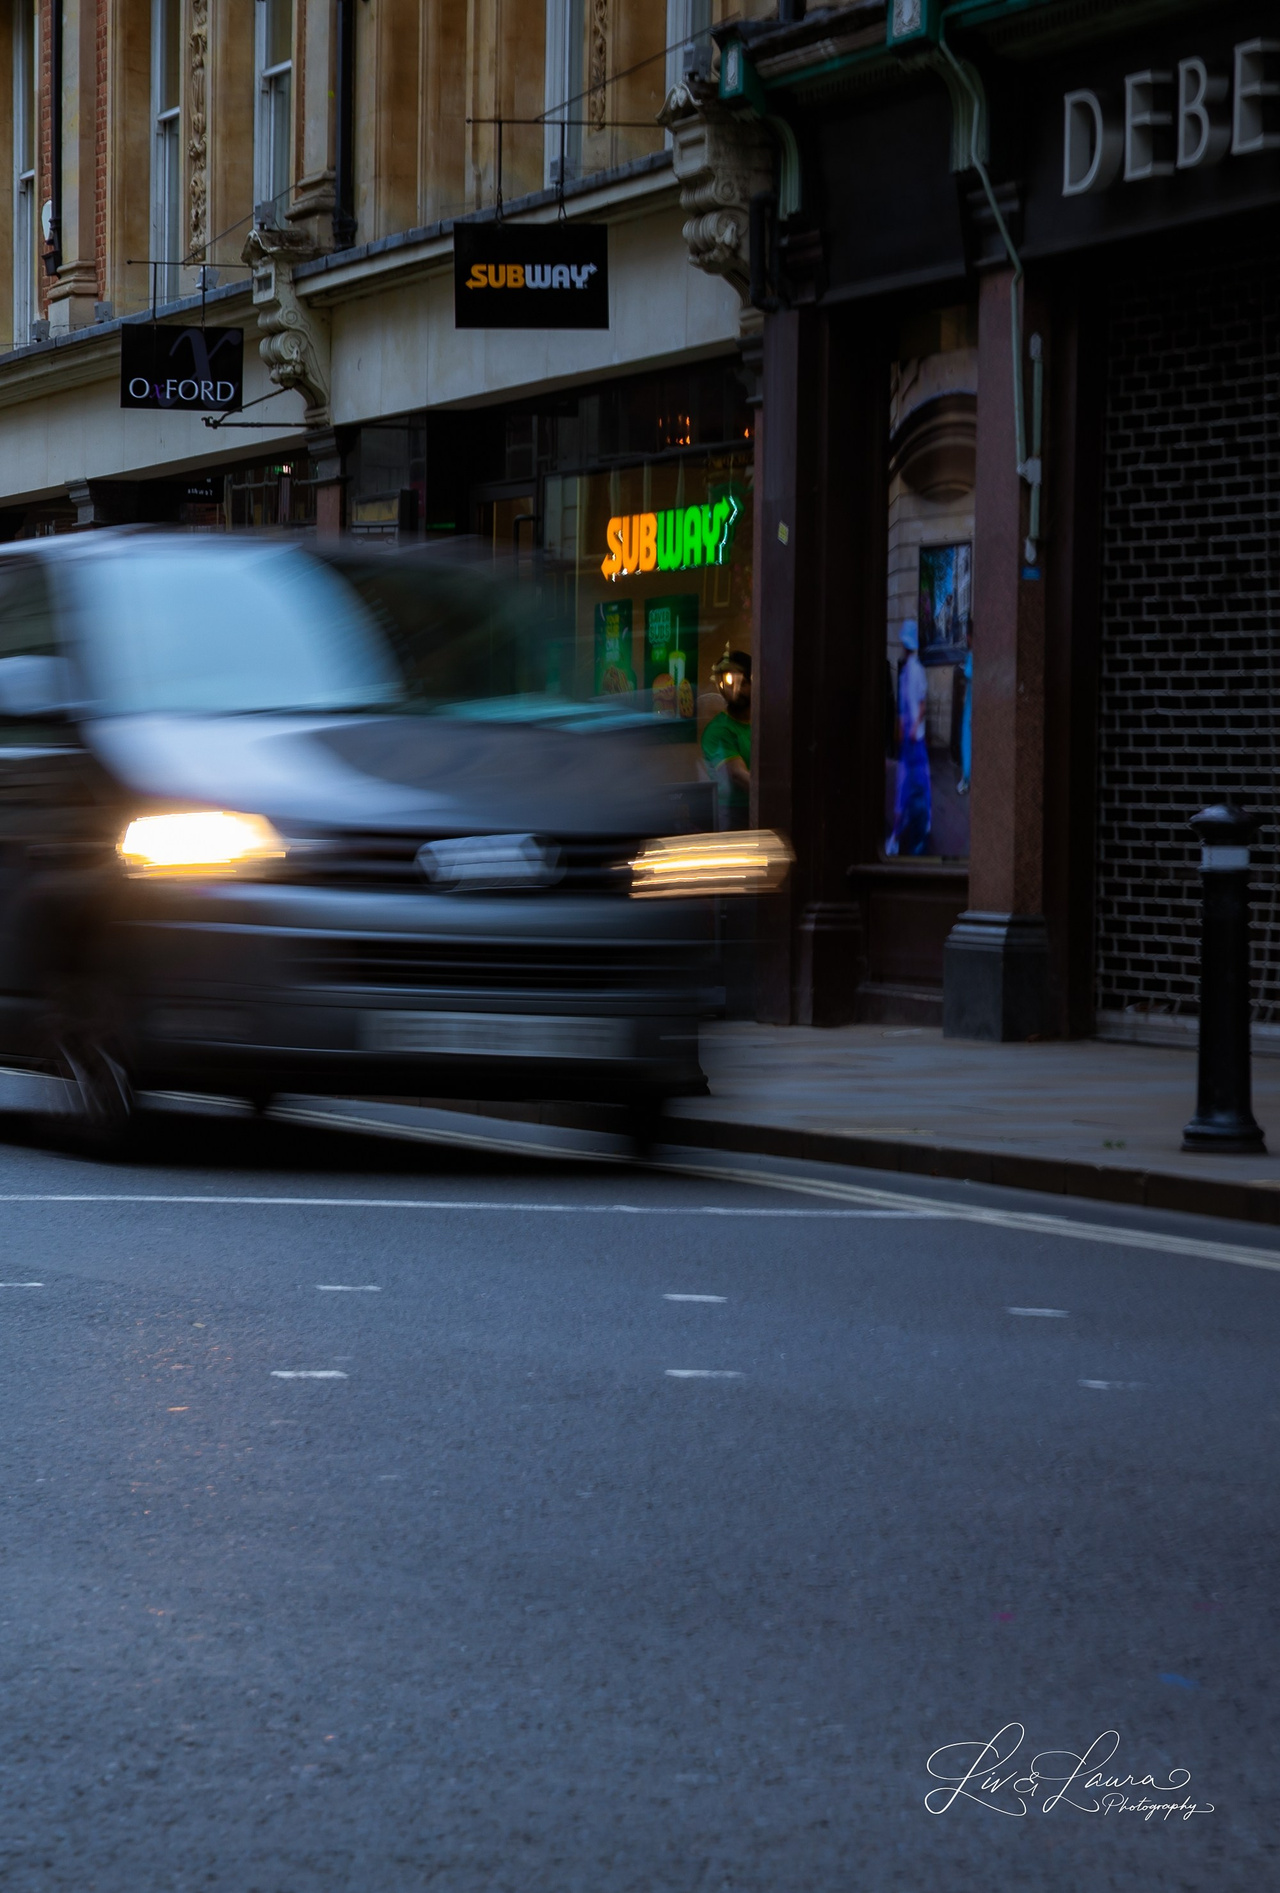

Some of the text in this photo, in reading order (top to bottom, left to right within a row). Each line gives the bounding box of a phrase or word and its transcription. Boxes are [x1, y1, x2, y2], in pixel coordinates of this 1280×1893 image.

[1061, 37, 1280, 198] DEBE
[465, 263, 598, 290] SUBWAY
[600, 495, 733, 582] SUBWAY
